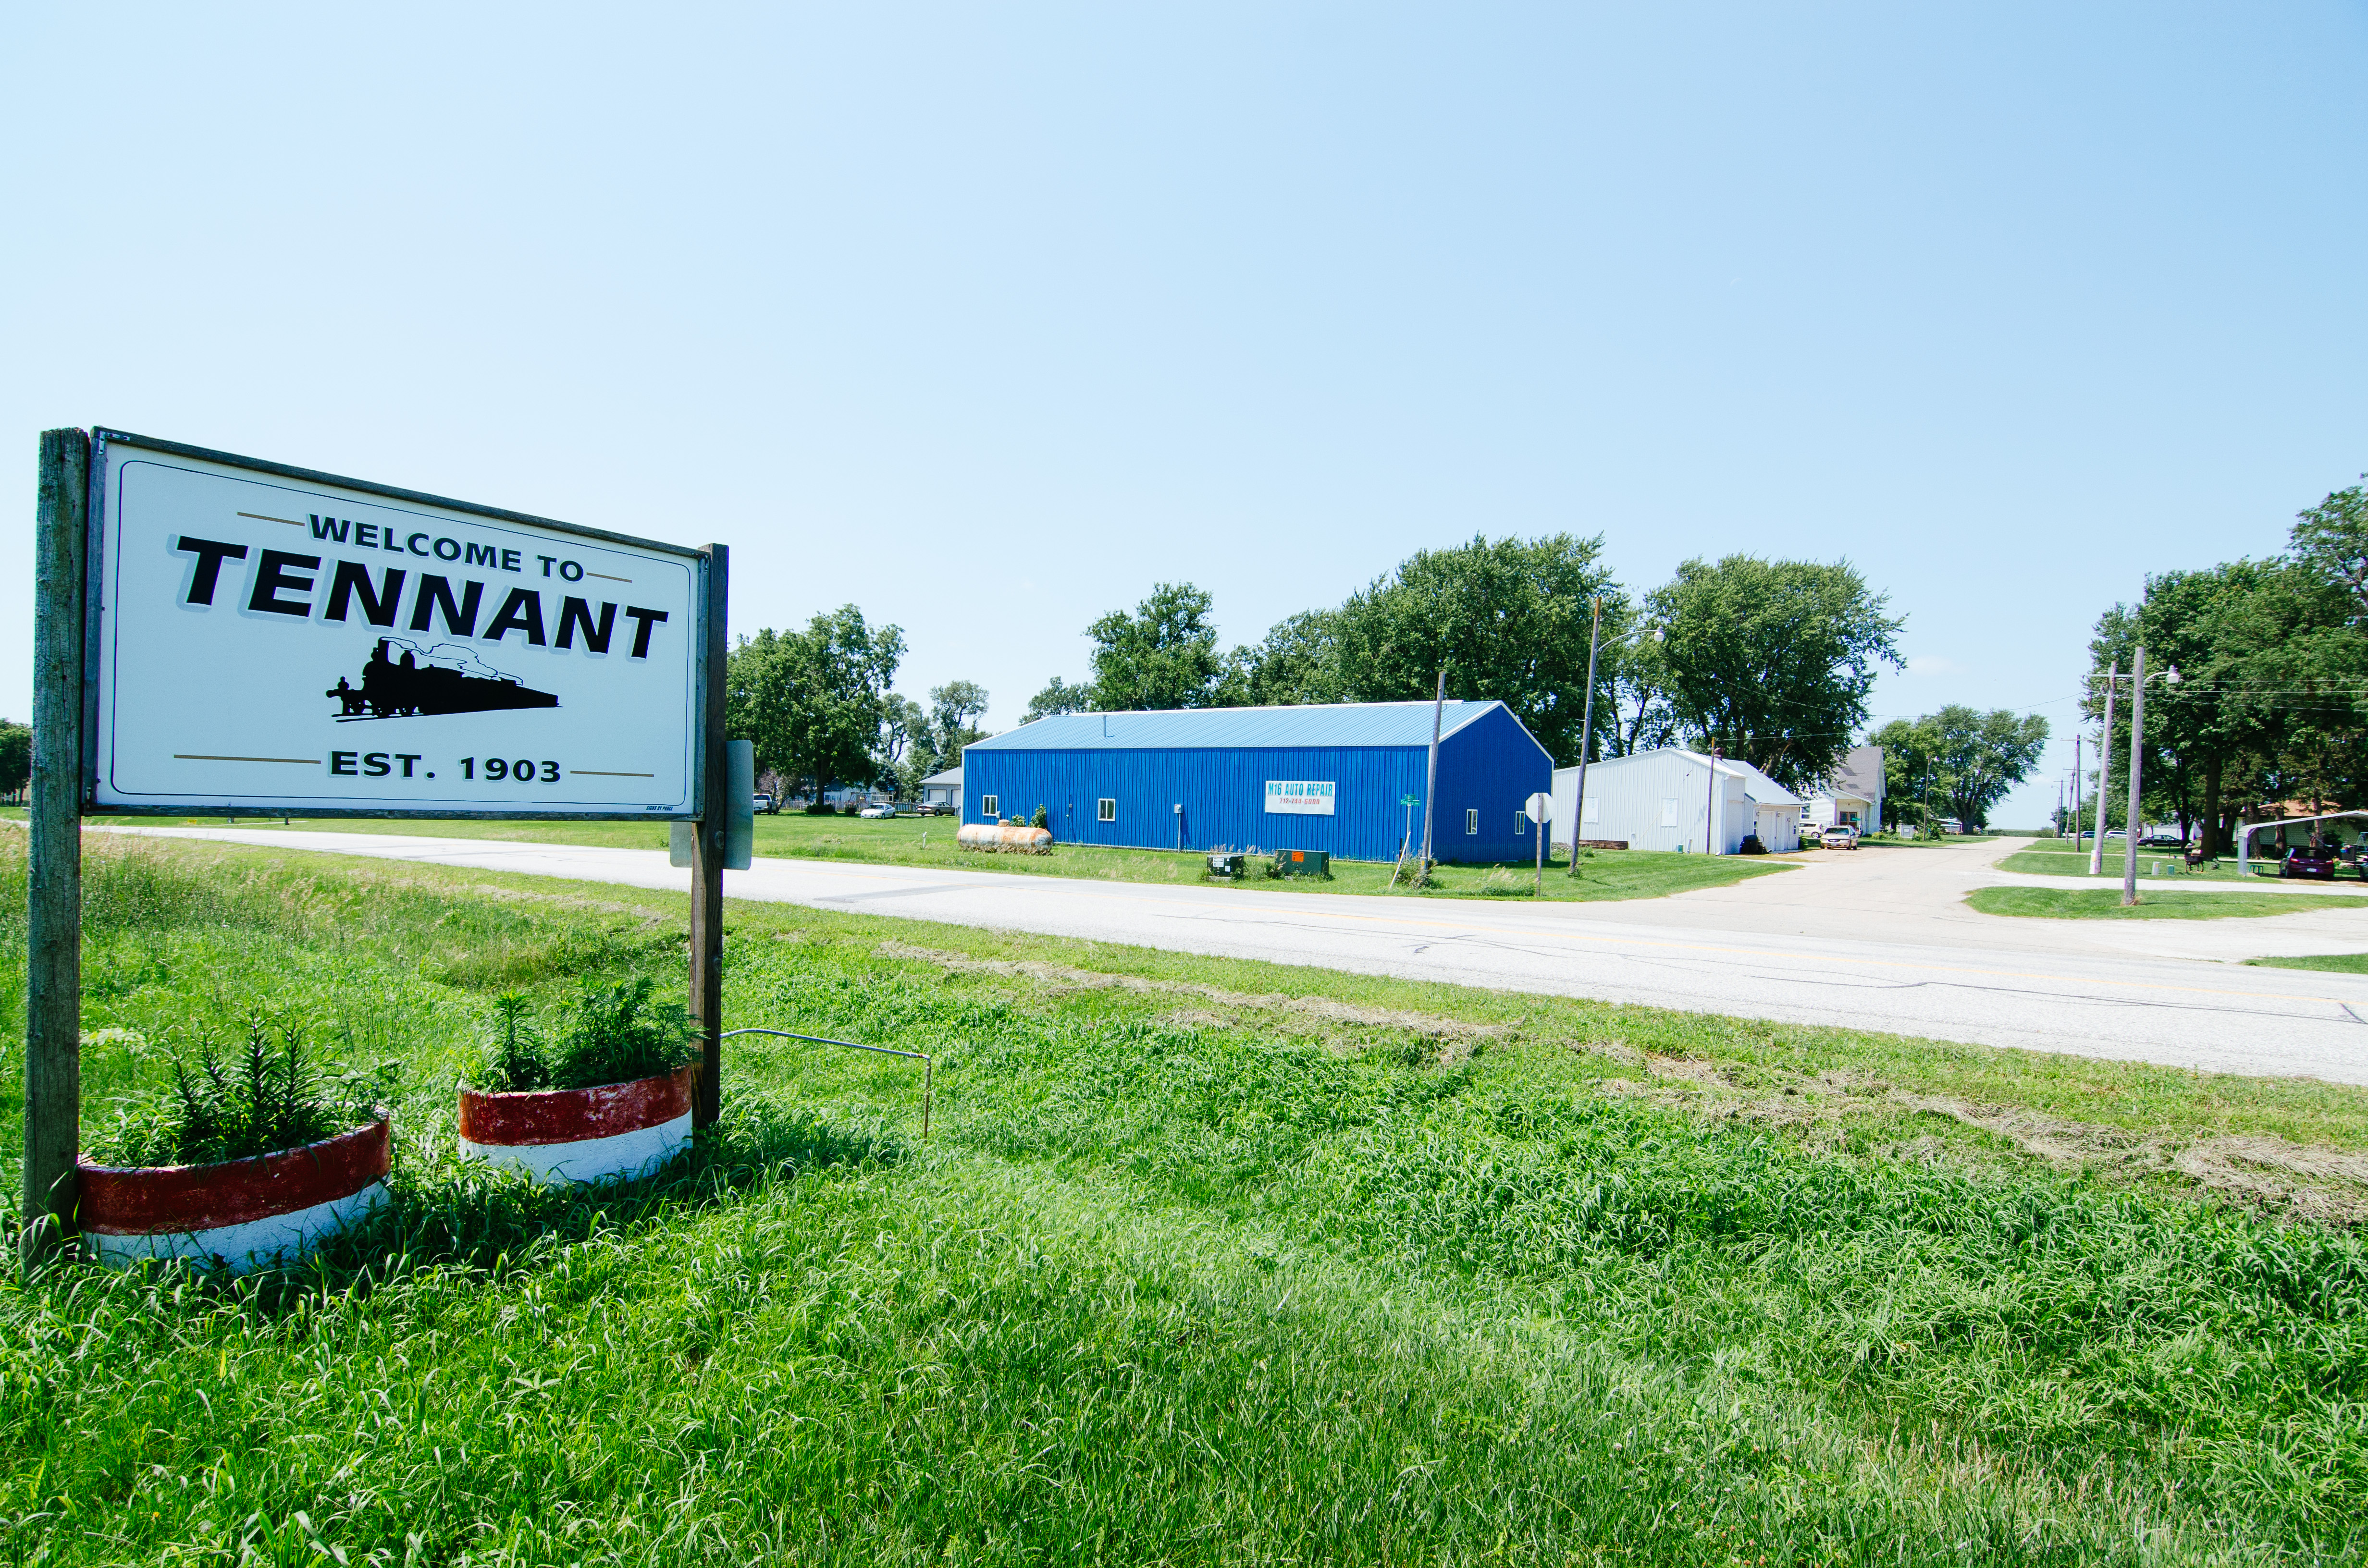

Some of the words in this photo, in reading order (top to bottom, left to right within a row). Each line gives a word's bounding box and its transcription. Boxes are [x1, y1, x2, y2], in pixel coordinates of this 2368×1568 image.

[309, 513, 522, 573] WELCOME
[537, 554, 584, 582] TO
[176, 535, 669, 660] TENNANT
[330, 750, 436, 779] EST.
[460, 756, 561, 783] 1903
[1268, 783, 1282, 796] M16
[1285, 783, 1303, 796] AUTO
[1307, 784, 1332, 796] REPAIR
